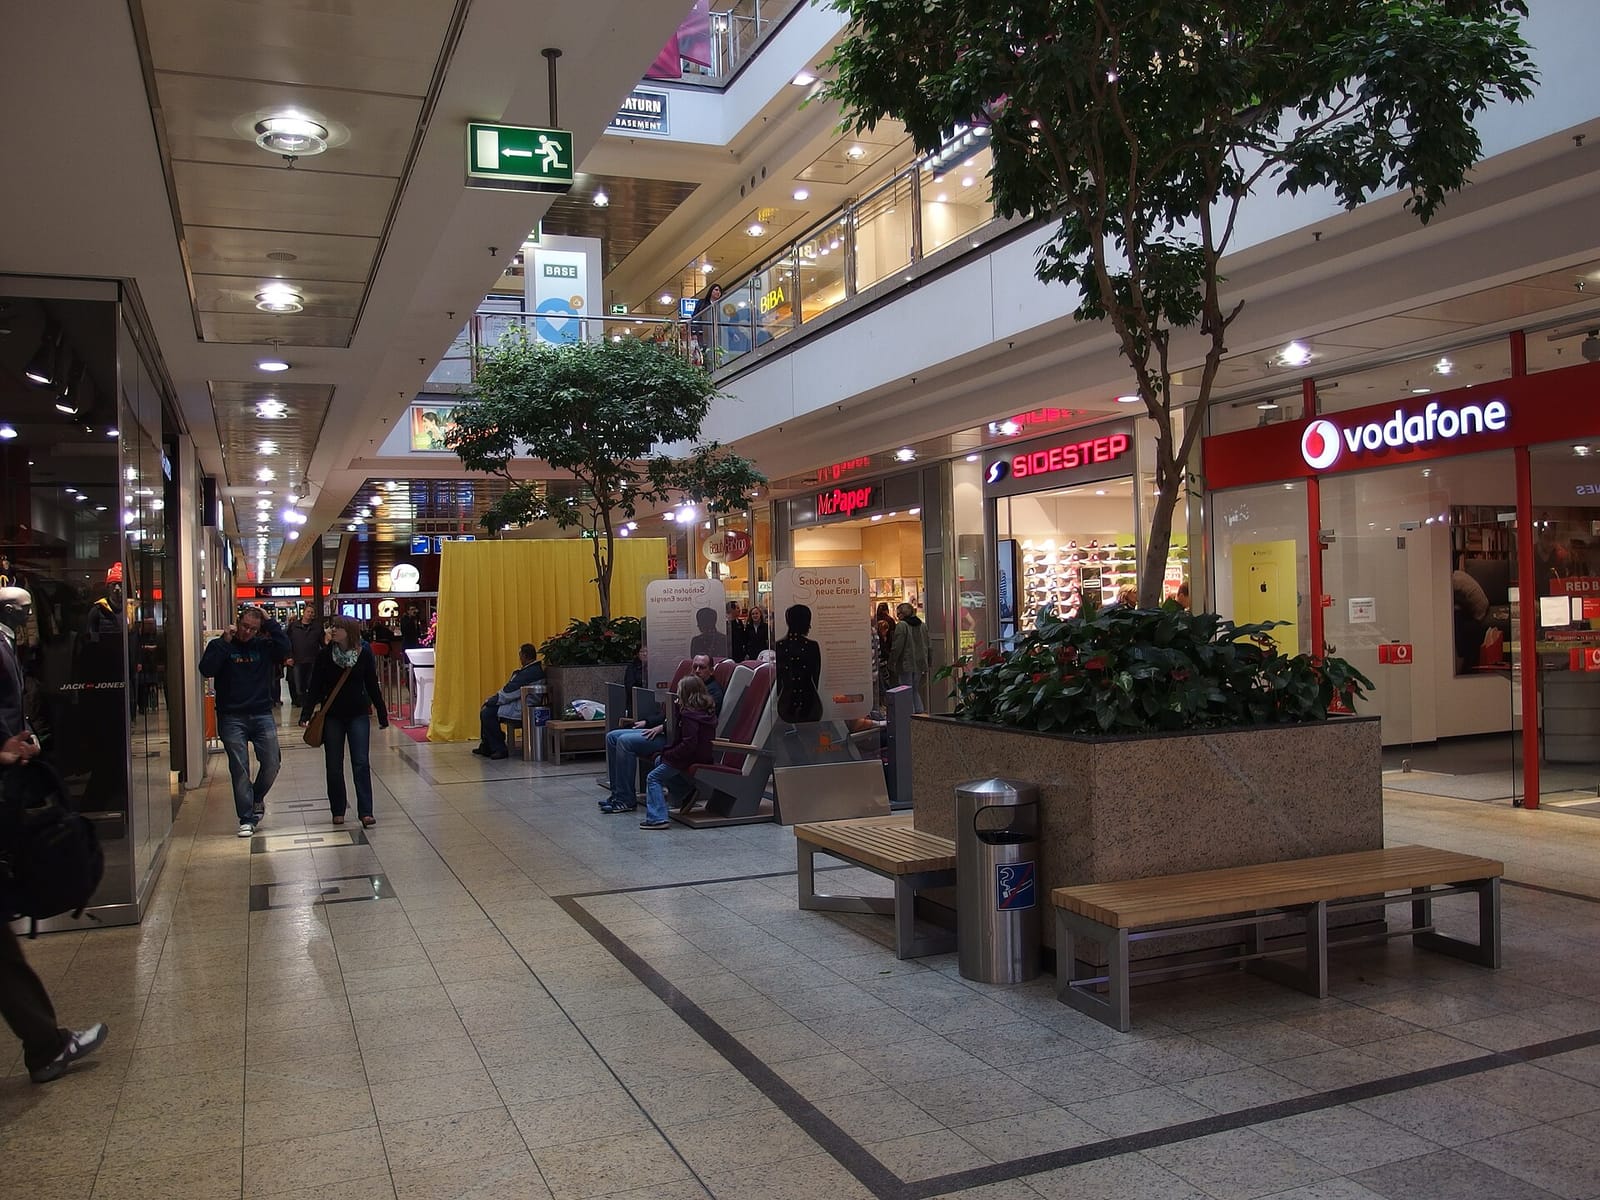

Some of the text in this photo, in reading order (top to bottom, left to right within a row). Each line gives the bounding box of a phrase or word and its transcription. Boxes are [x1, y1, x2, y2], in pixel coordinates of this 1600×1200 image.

[615, 118, 661, 130] BASEMENT
[545, 265, 576, 277] BASE
[1343, 401, 1506, 453] vodafone
[1012, 433, 1128, 479] SIDESTEP
[818, 486, 872, 517] McPaper
[799, 576, 850, 587] Schöpfen Sie
[1566, 581, 1590, 592] RED
[95, 681, 126, 689] JONES
